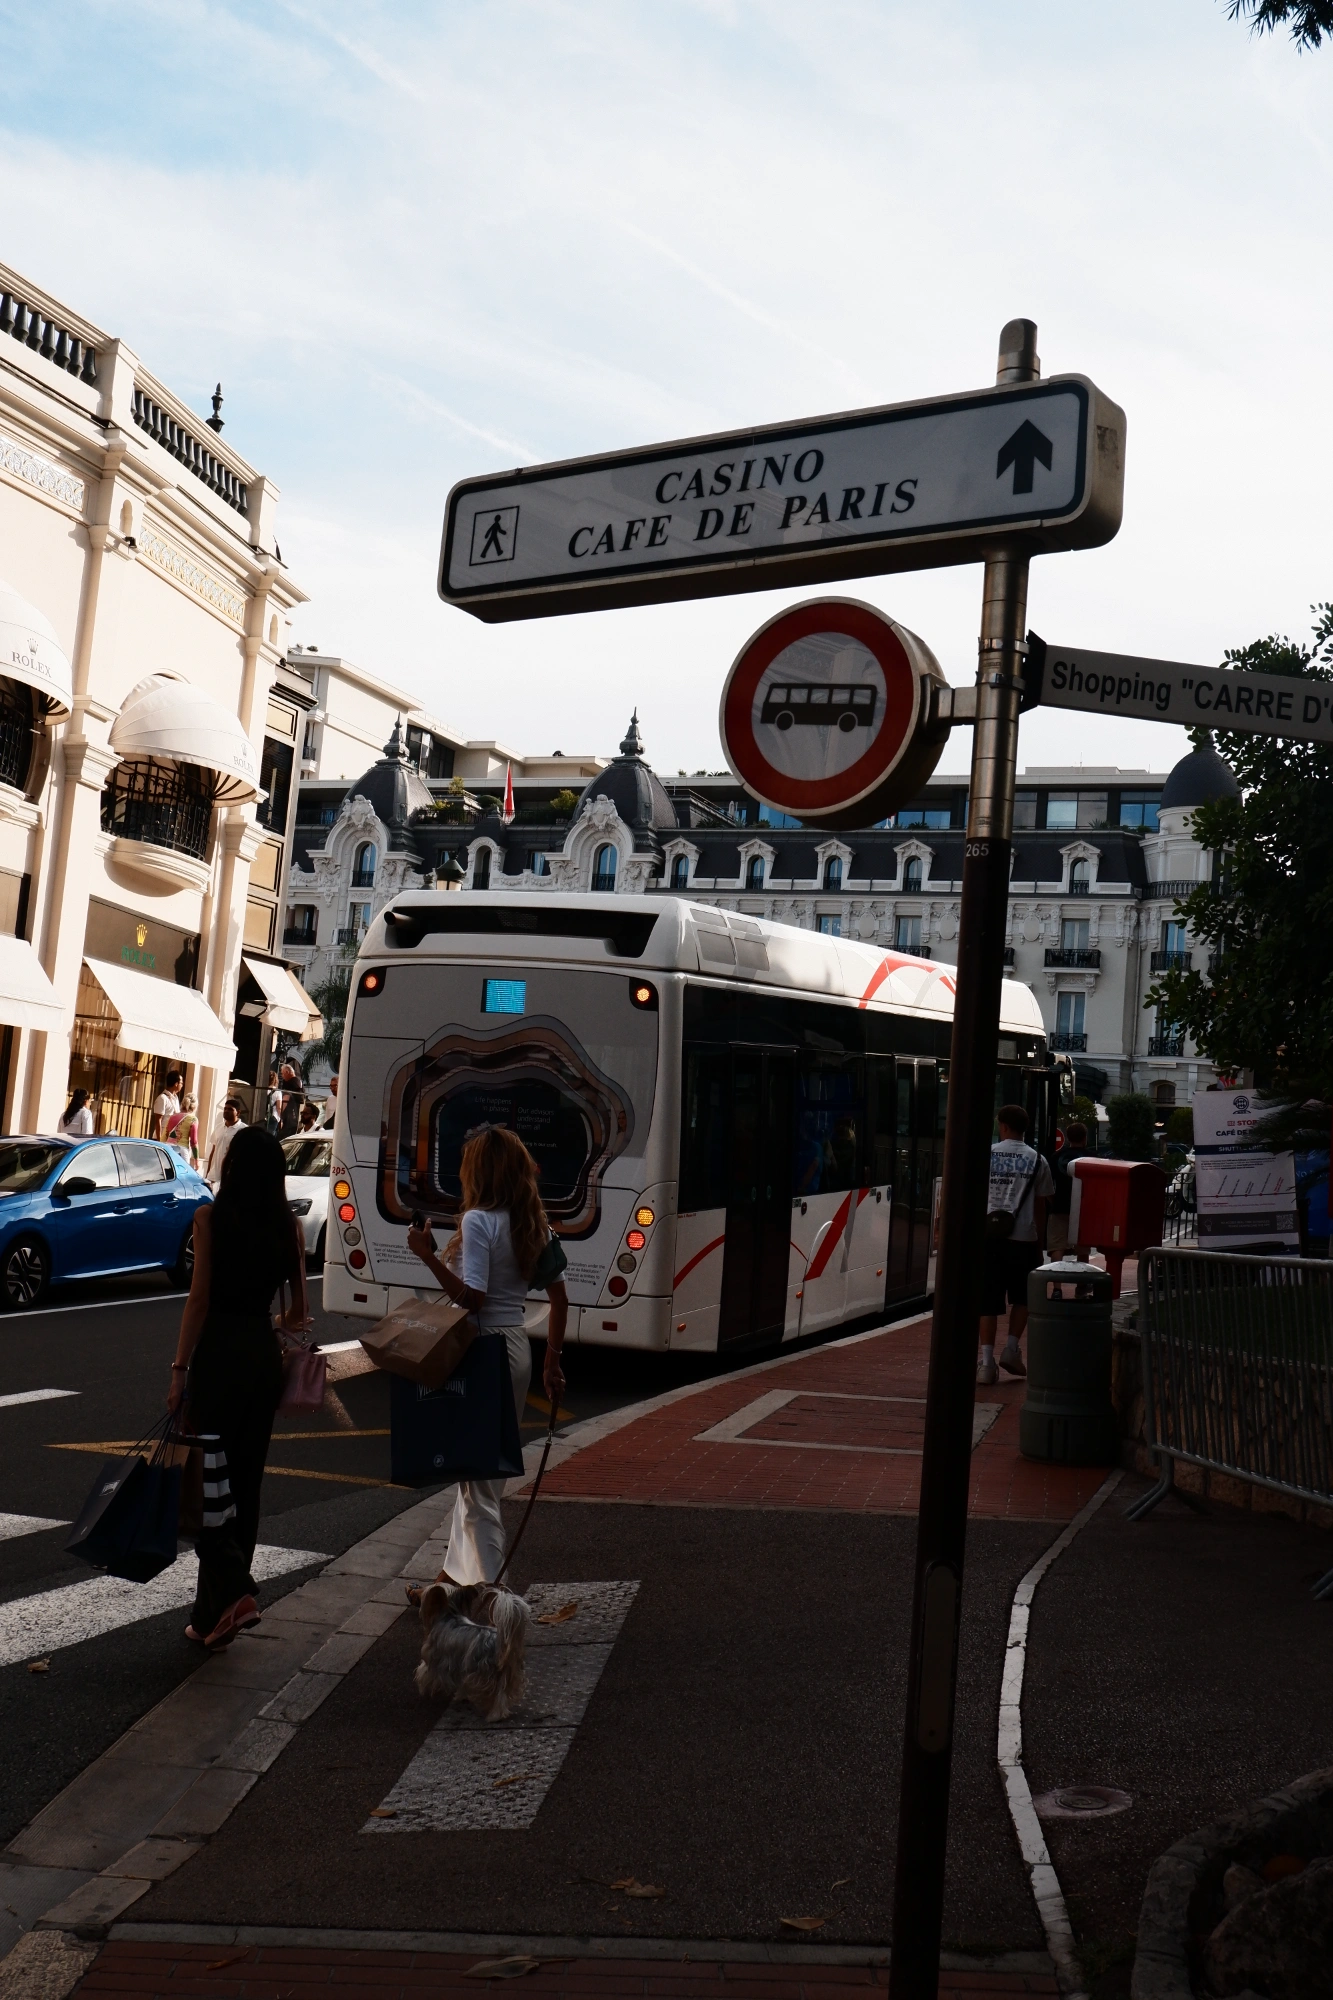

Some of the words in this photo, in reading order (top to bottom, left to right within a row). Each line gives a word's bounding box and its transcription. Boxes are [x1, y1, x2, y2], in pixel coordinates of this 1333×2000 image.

[655, 449, 825, 504] CASINO
[568, 514, 672, 558] CAFE
[693, 502, 755, 542] DE
[777, 478, 919, 530] PARIS
[11, 651, 52, 679] ROLEX
[1051, 661, 1172, 712] Shopping
[1181, 677, 1294, 721] "CARRE
[965, 843, 990, 858] 265
[121, 945, 156, 970] ROLEX
[475, 1096, 486, 1104] Life
[487, 1097, 512, 1106] happens
[518, 1106, 530, 1114] Our
[516, 1123, 532, 1131] them
[517, 1115, 551, 1124] understand
[1215, 1129, 1236, 1137] CAFÉ
[332, 1166, 346, 1175] 205
[418, 1380, 464, 1399] VILQUIN
